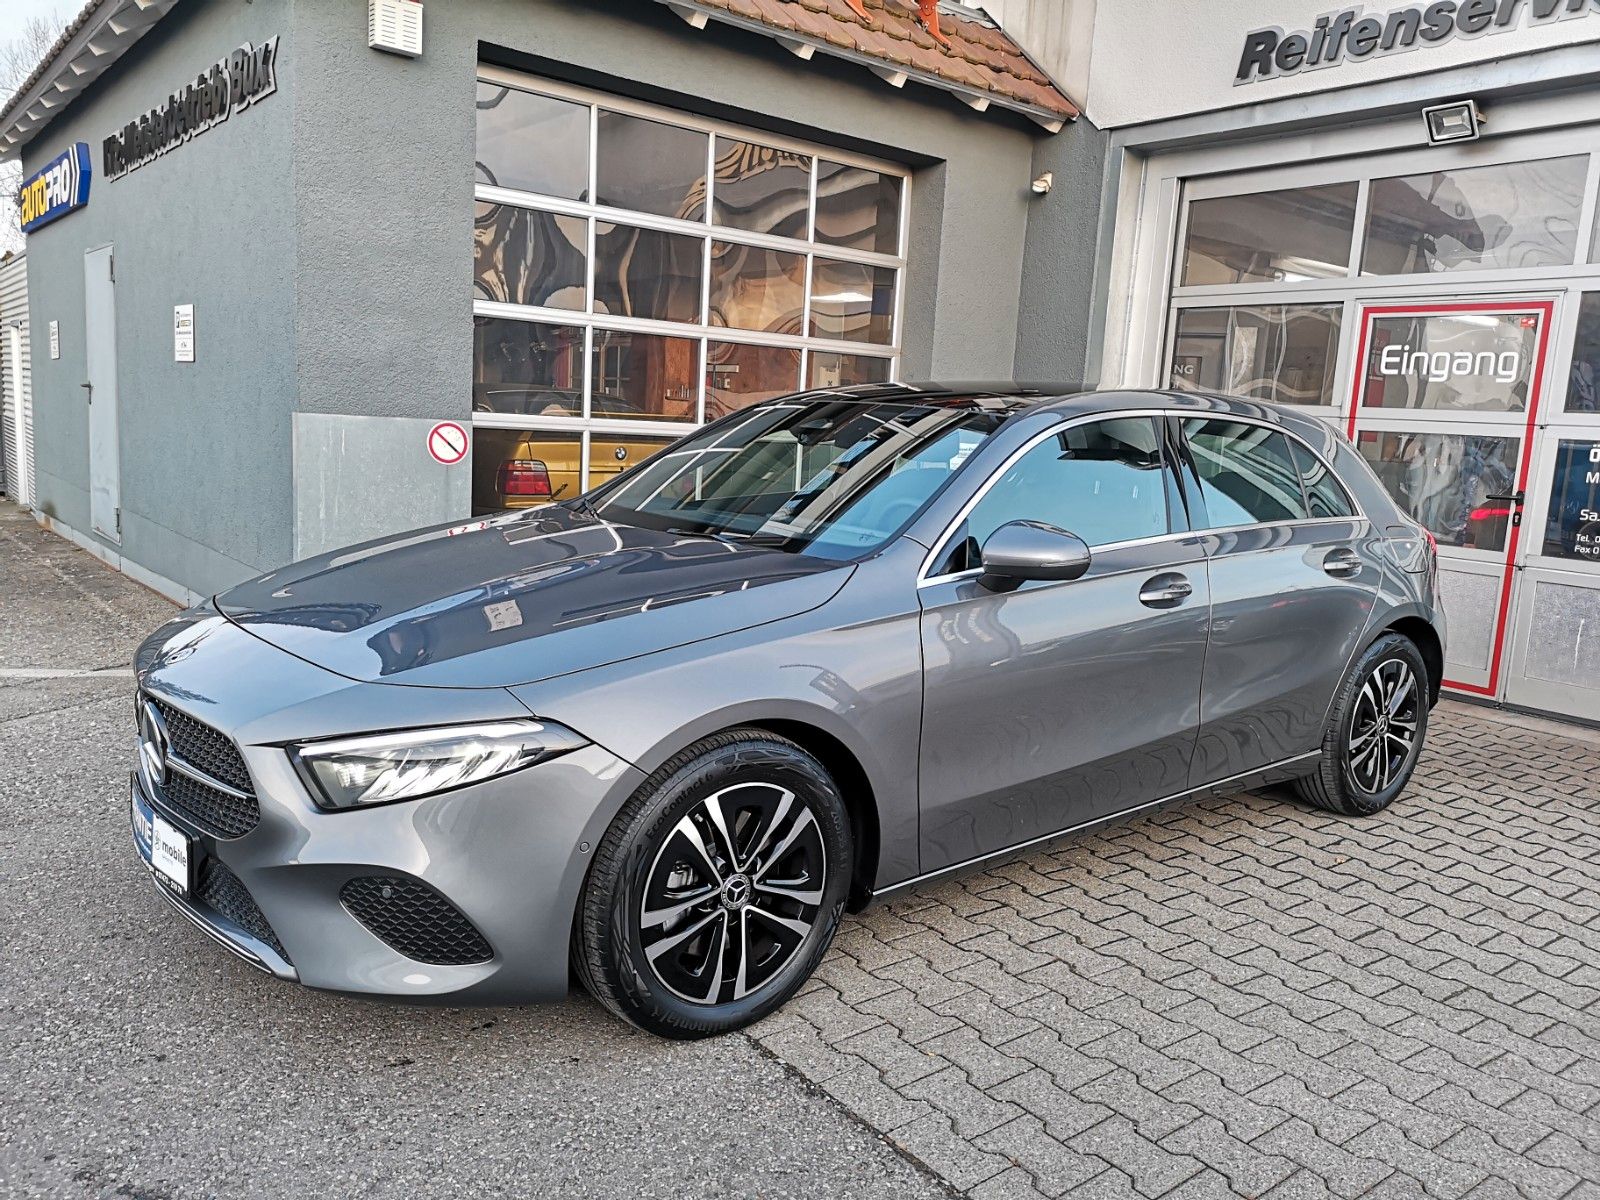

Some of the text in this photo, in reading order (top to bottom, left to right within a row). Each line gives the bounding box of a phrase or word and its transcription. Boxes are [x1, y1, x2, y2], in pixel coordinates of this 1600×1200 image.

[1236, 0, 1600, 80] Reifenser
[1380, 344, 1519, 383] Eingang
[1573, 545, 1591, 554] Fax
[645, 777, 703, 839] EcoContact
[161, 840, 187, 868] mobile
